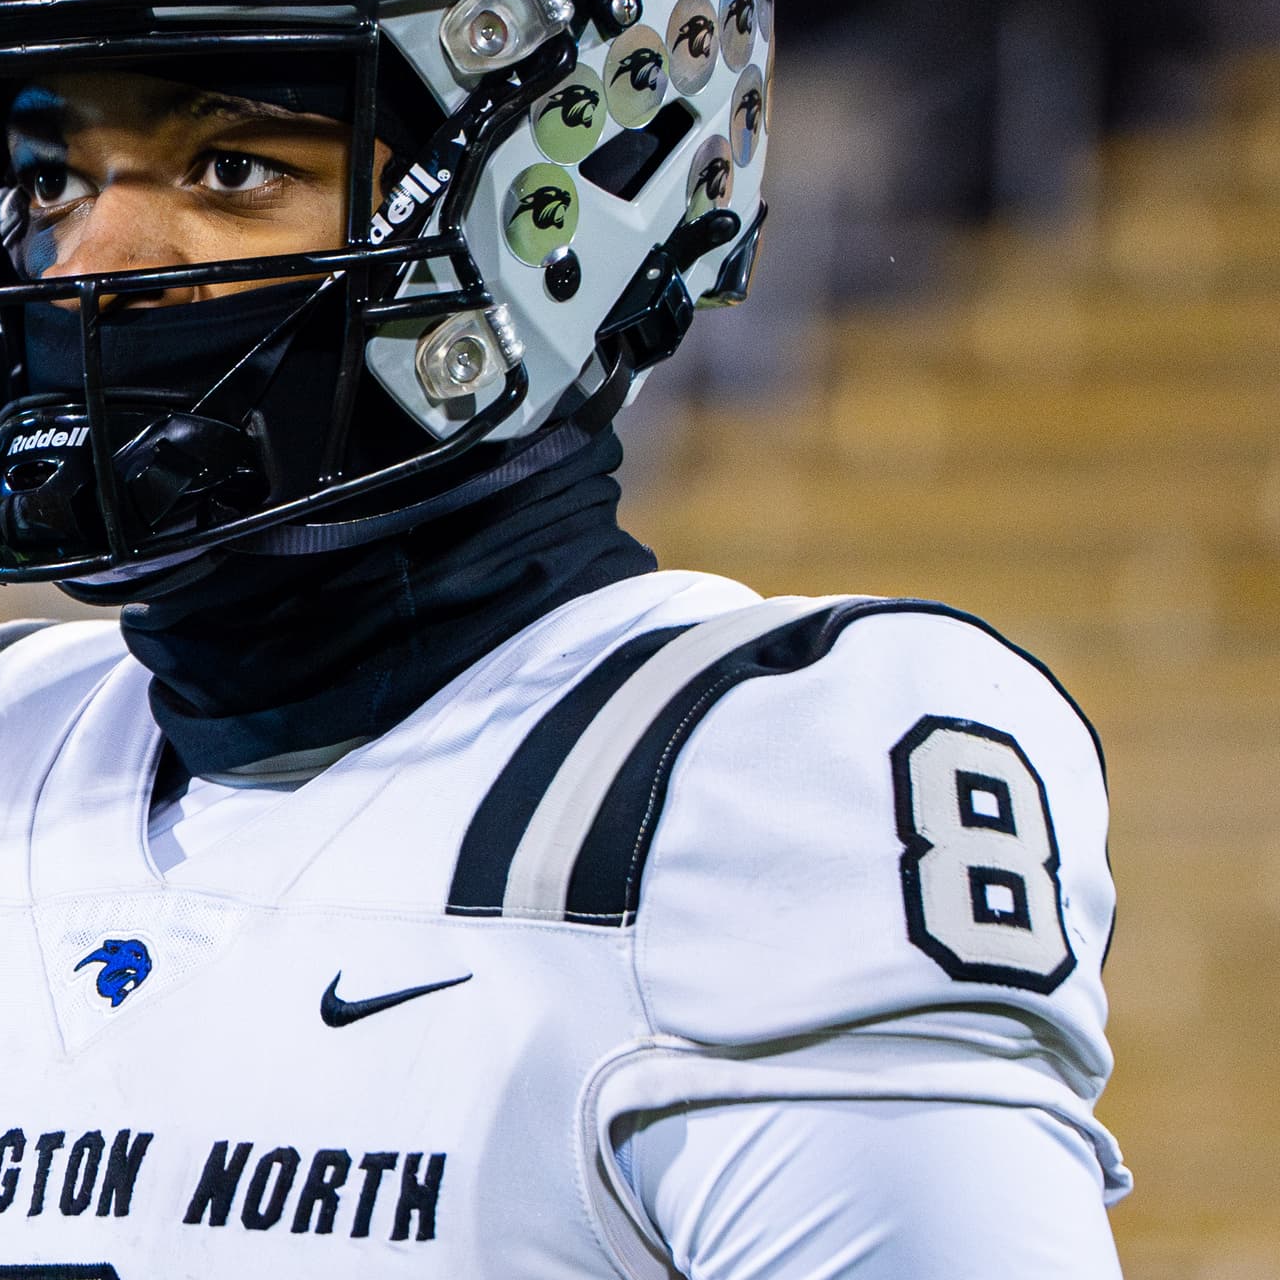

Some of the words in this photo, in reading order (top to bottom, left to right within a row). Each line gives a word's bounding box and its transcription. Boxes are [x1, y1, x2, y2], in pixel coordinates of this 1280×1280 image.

[7, 426, 90, 457] Riddell
[889, 714, 1078, 996] 8
[182, 1140, 447, 1242] NORTH
